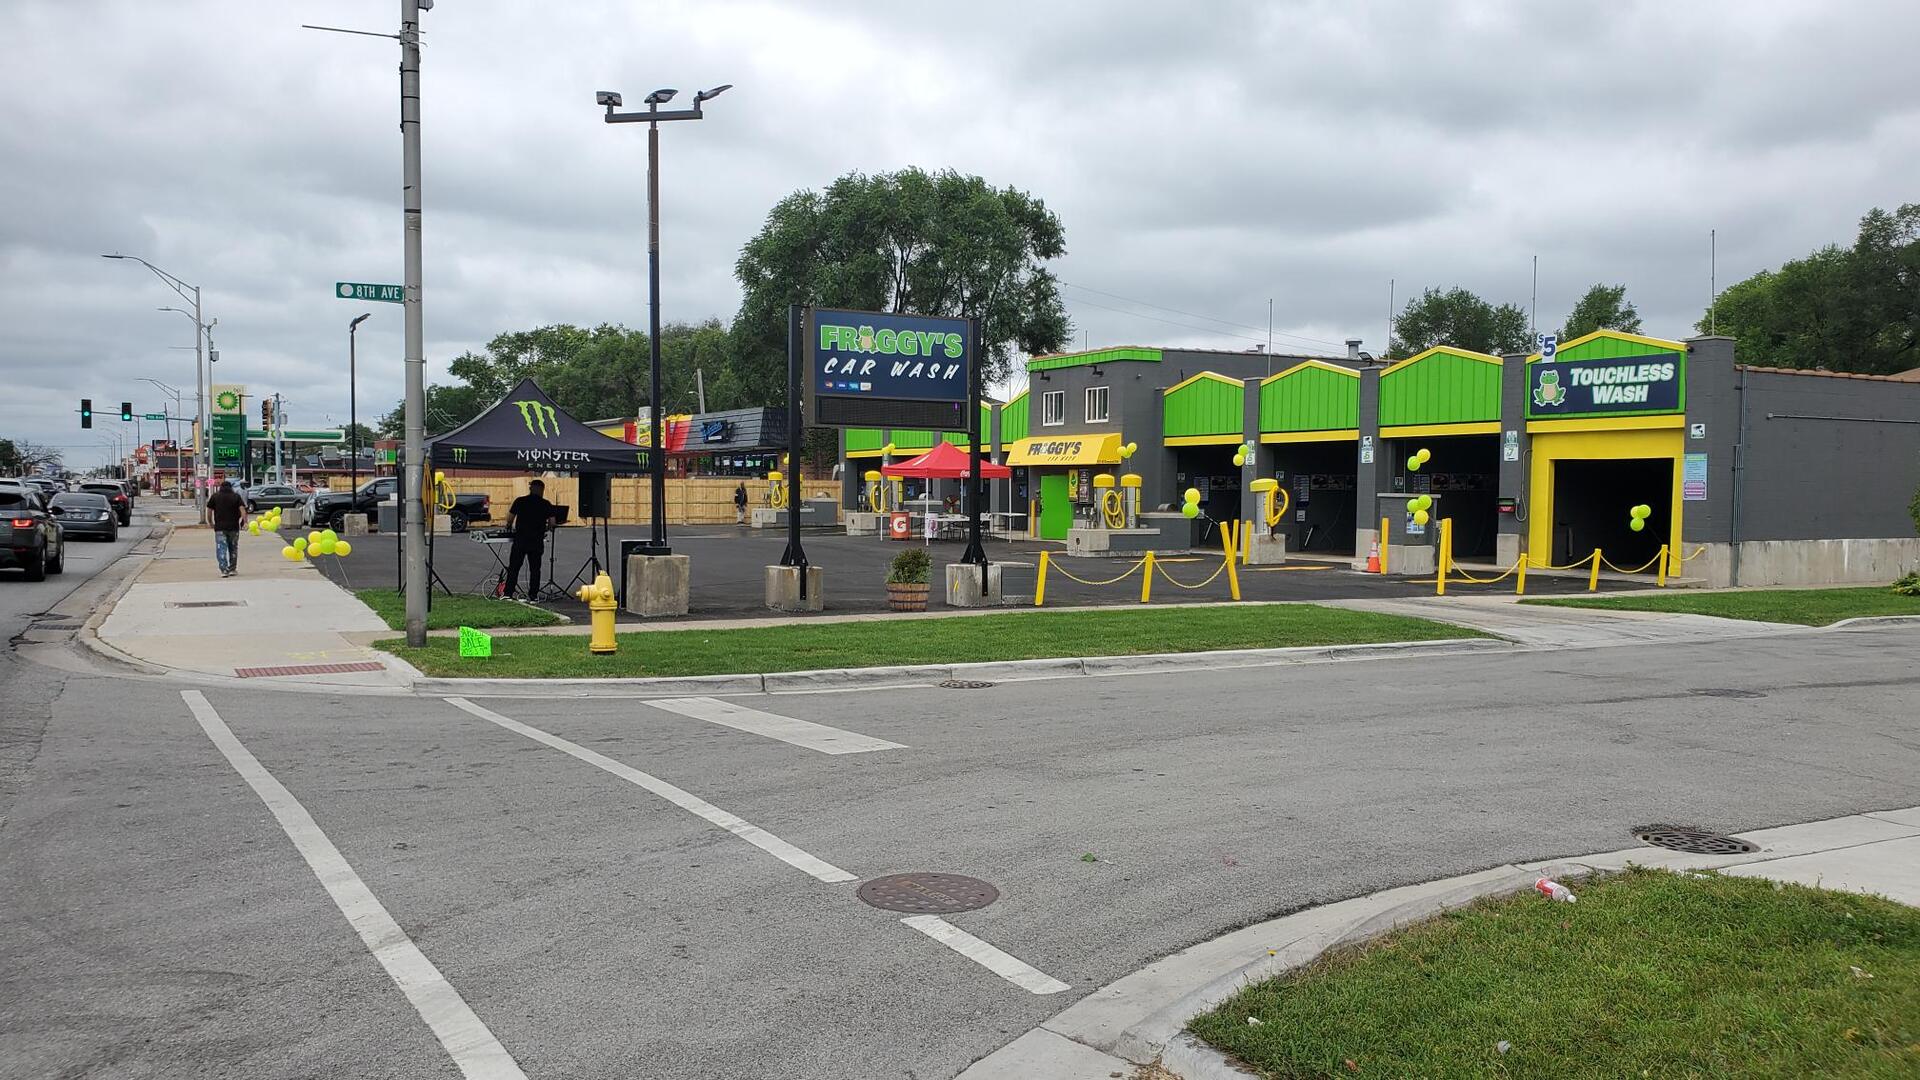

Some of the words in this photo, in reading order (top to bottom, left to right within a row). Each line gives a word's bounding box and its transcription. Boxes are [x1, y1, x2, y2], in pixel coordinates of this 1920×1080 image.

[356, 285, 375, 298] 8TH
[381, 286, 400, 299] AVE
[1537, 333, 1556, 357] $5
[824, 357, 877, 375] CAR
[890, 360, 960, 380] WASH
[1570, 362, 1675, 387] TOUCHLESS
[1592, 384, 1649, 405] WASH
[517, 448, 590, 462] MONSTER
[893, 517, 907, 533] G
